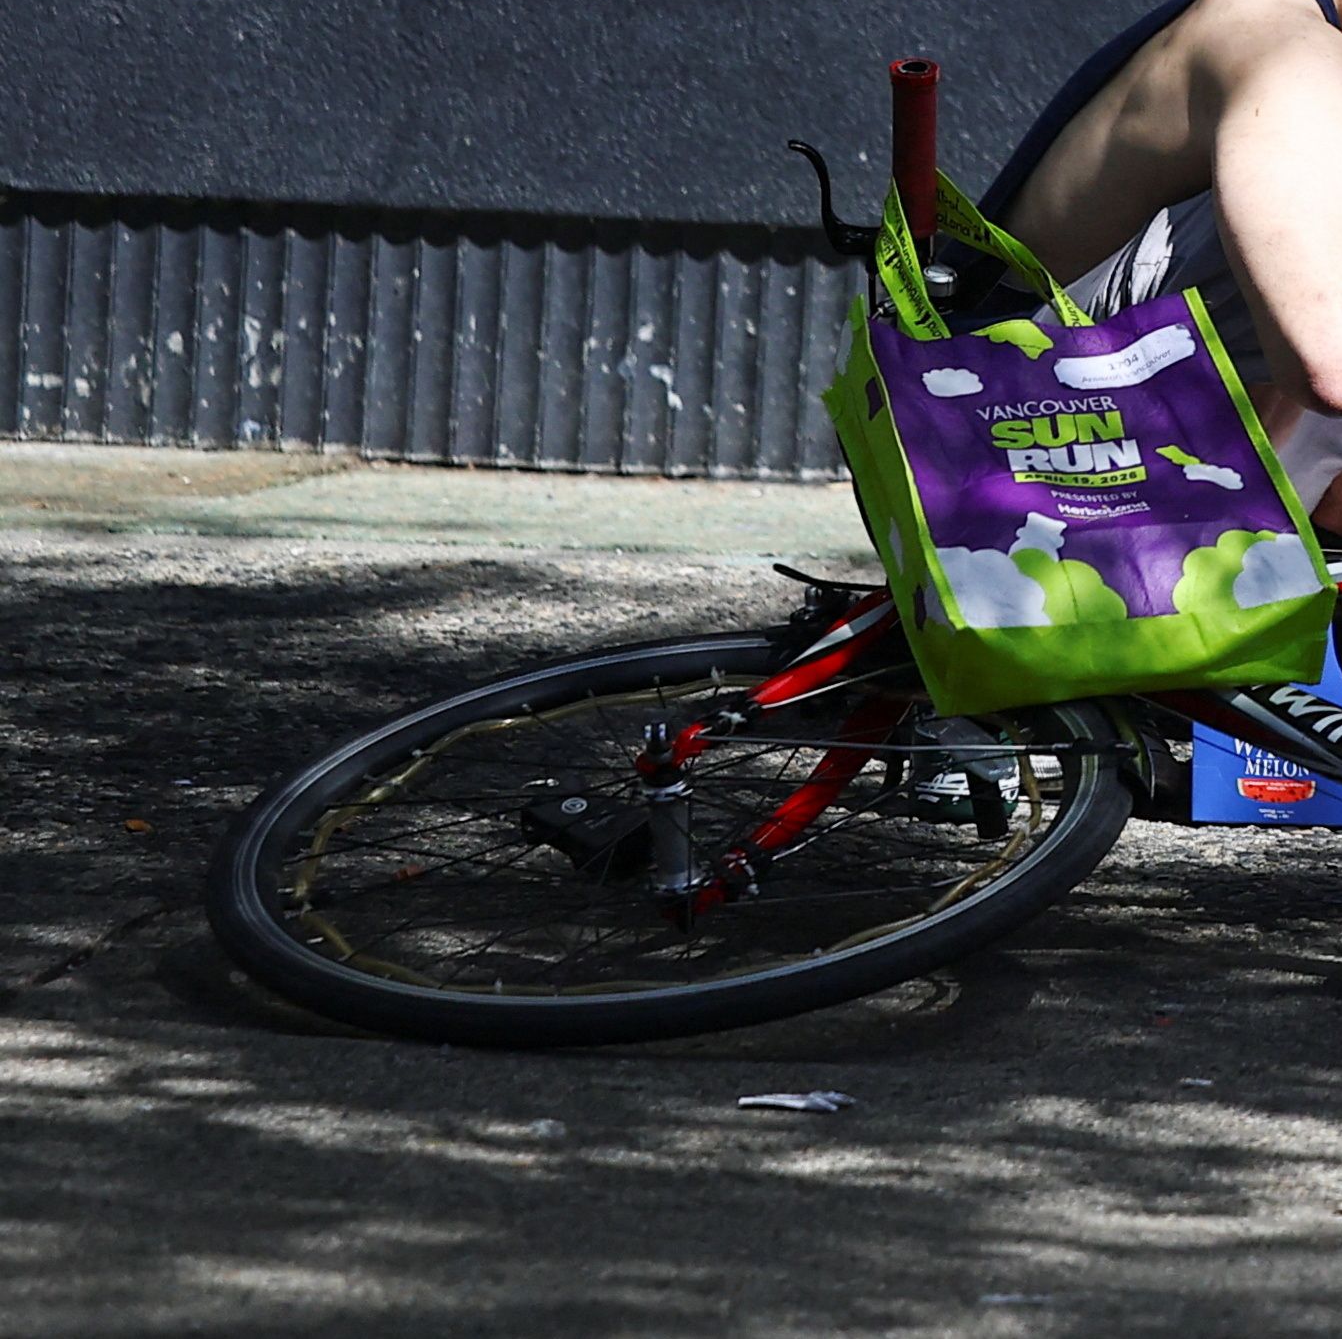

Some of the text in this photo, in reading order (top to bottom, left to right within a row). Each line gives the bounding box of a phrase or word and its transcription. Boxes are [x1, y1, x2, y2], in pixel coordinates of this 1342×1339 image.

[976, 396, 1118, 421] VANCOUVER
[991, 410, 1125, 449] SUN
[1006, 439, 1142, 473] RUN
[1024, 473, 1066, 484] APRIL
[1100, 471, 1138, 484] 2026
[1050, 490, 1137, 503] PRESENTED BY
